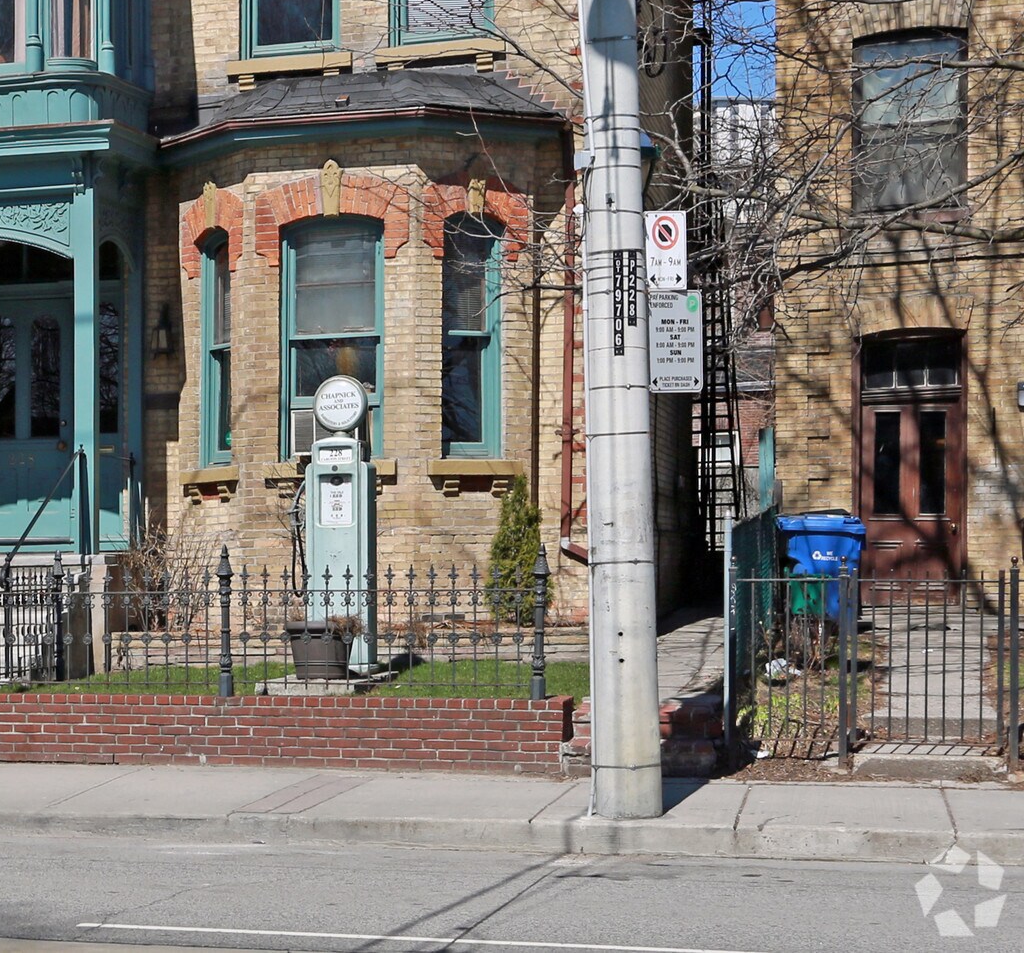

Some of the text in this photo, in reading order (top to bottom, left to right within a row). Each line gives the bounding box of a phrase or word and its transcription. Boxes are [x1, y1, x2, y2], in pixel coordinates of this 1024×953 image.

[650, 257, 662, 266] 7AM
[668, 256, 681, 266] 9AM
[321, 391, 356, 399] CHAPNICK
[319, 402, 359, 411] ASSOCIATES
[329, 449, 343, 457] 228
